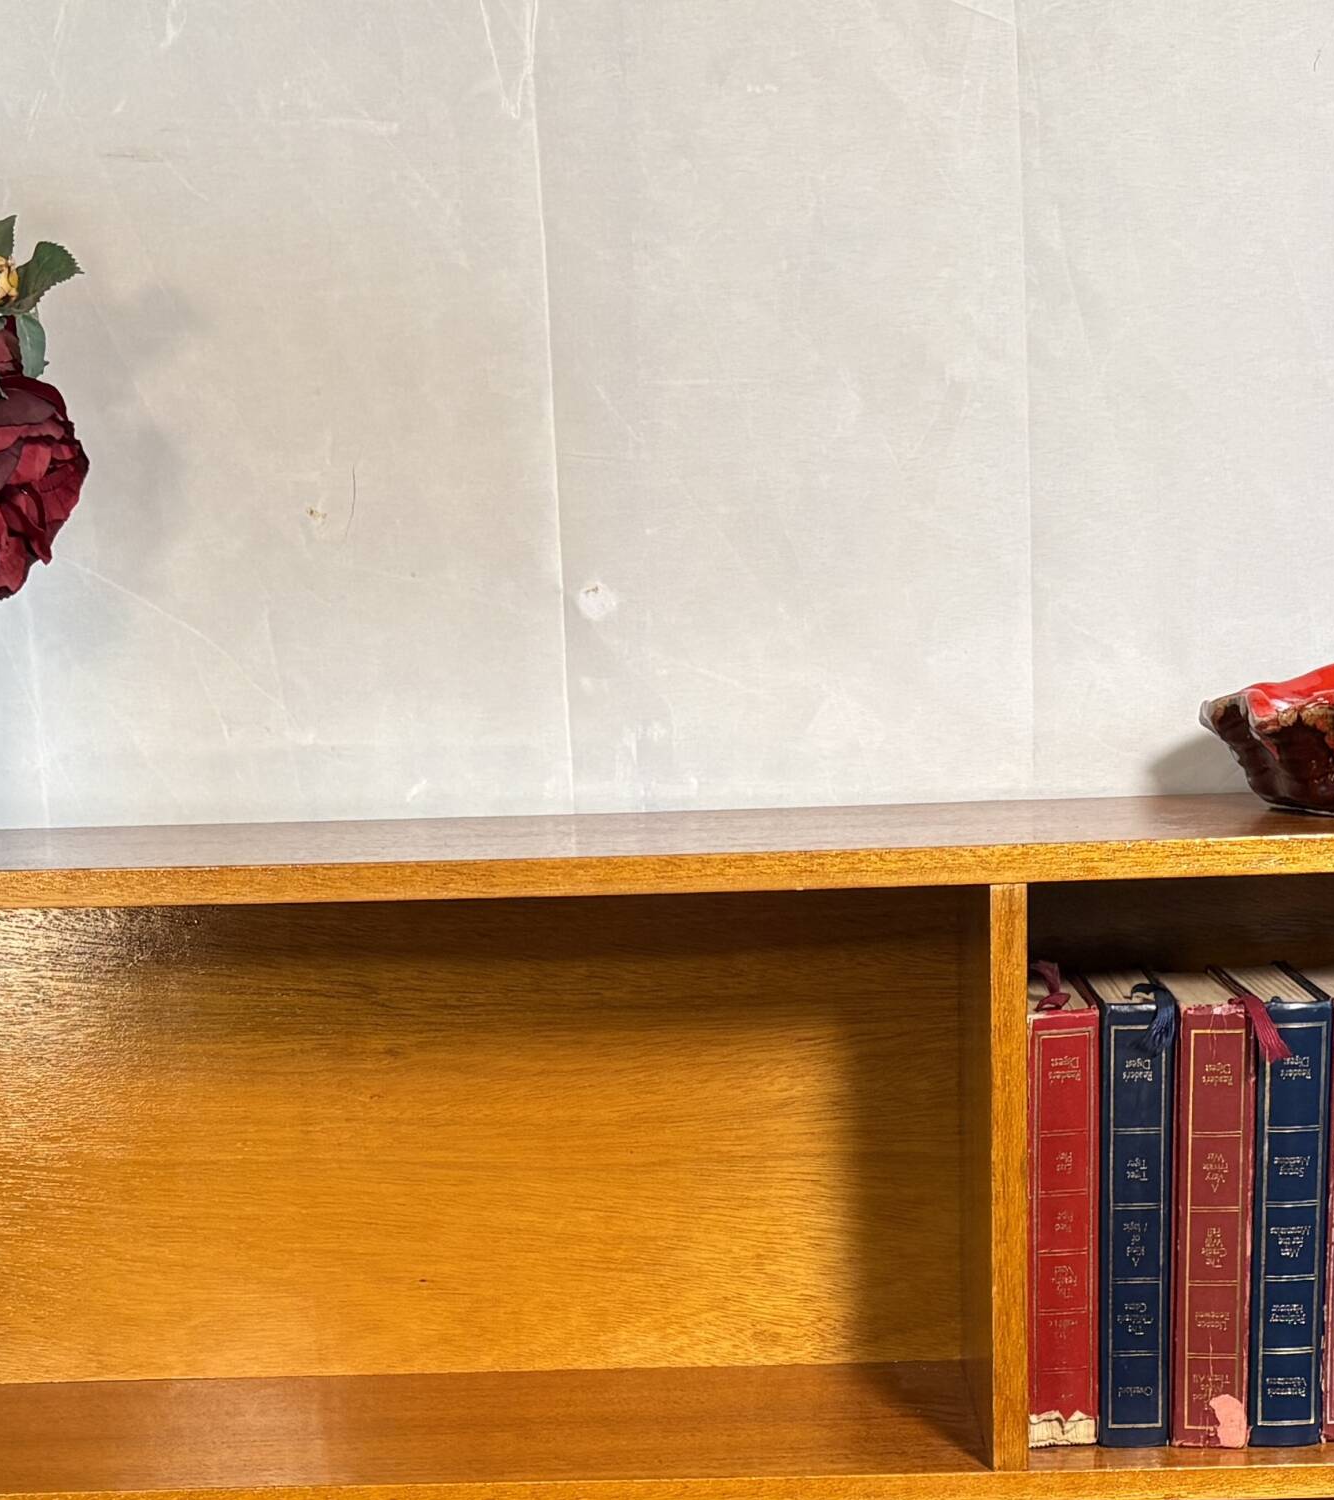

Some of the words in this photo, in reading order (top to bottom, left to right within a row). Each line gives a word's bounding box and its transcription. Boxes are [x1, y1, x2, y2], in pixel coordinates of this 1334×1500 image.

[1125, 1057, 1151, 1070] Digest
[1122, 1069, 1153, 1082] Reader's
[1211, 1183, 1219, 1193] A
[1133, 1257, 1140, 1267] A
[1205, 1257, 1222, 1268] The
